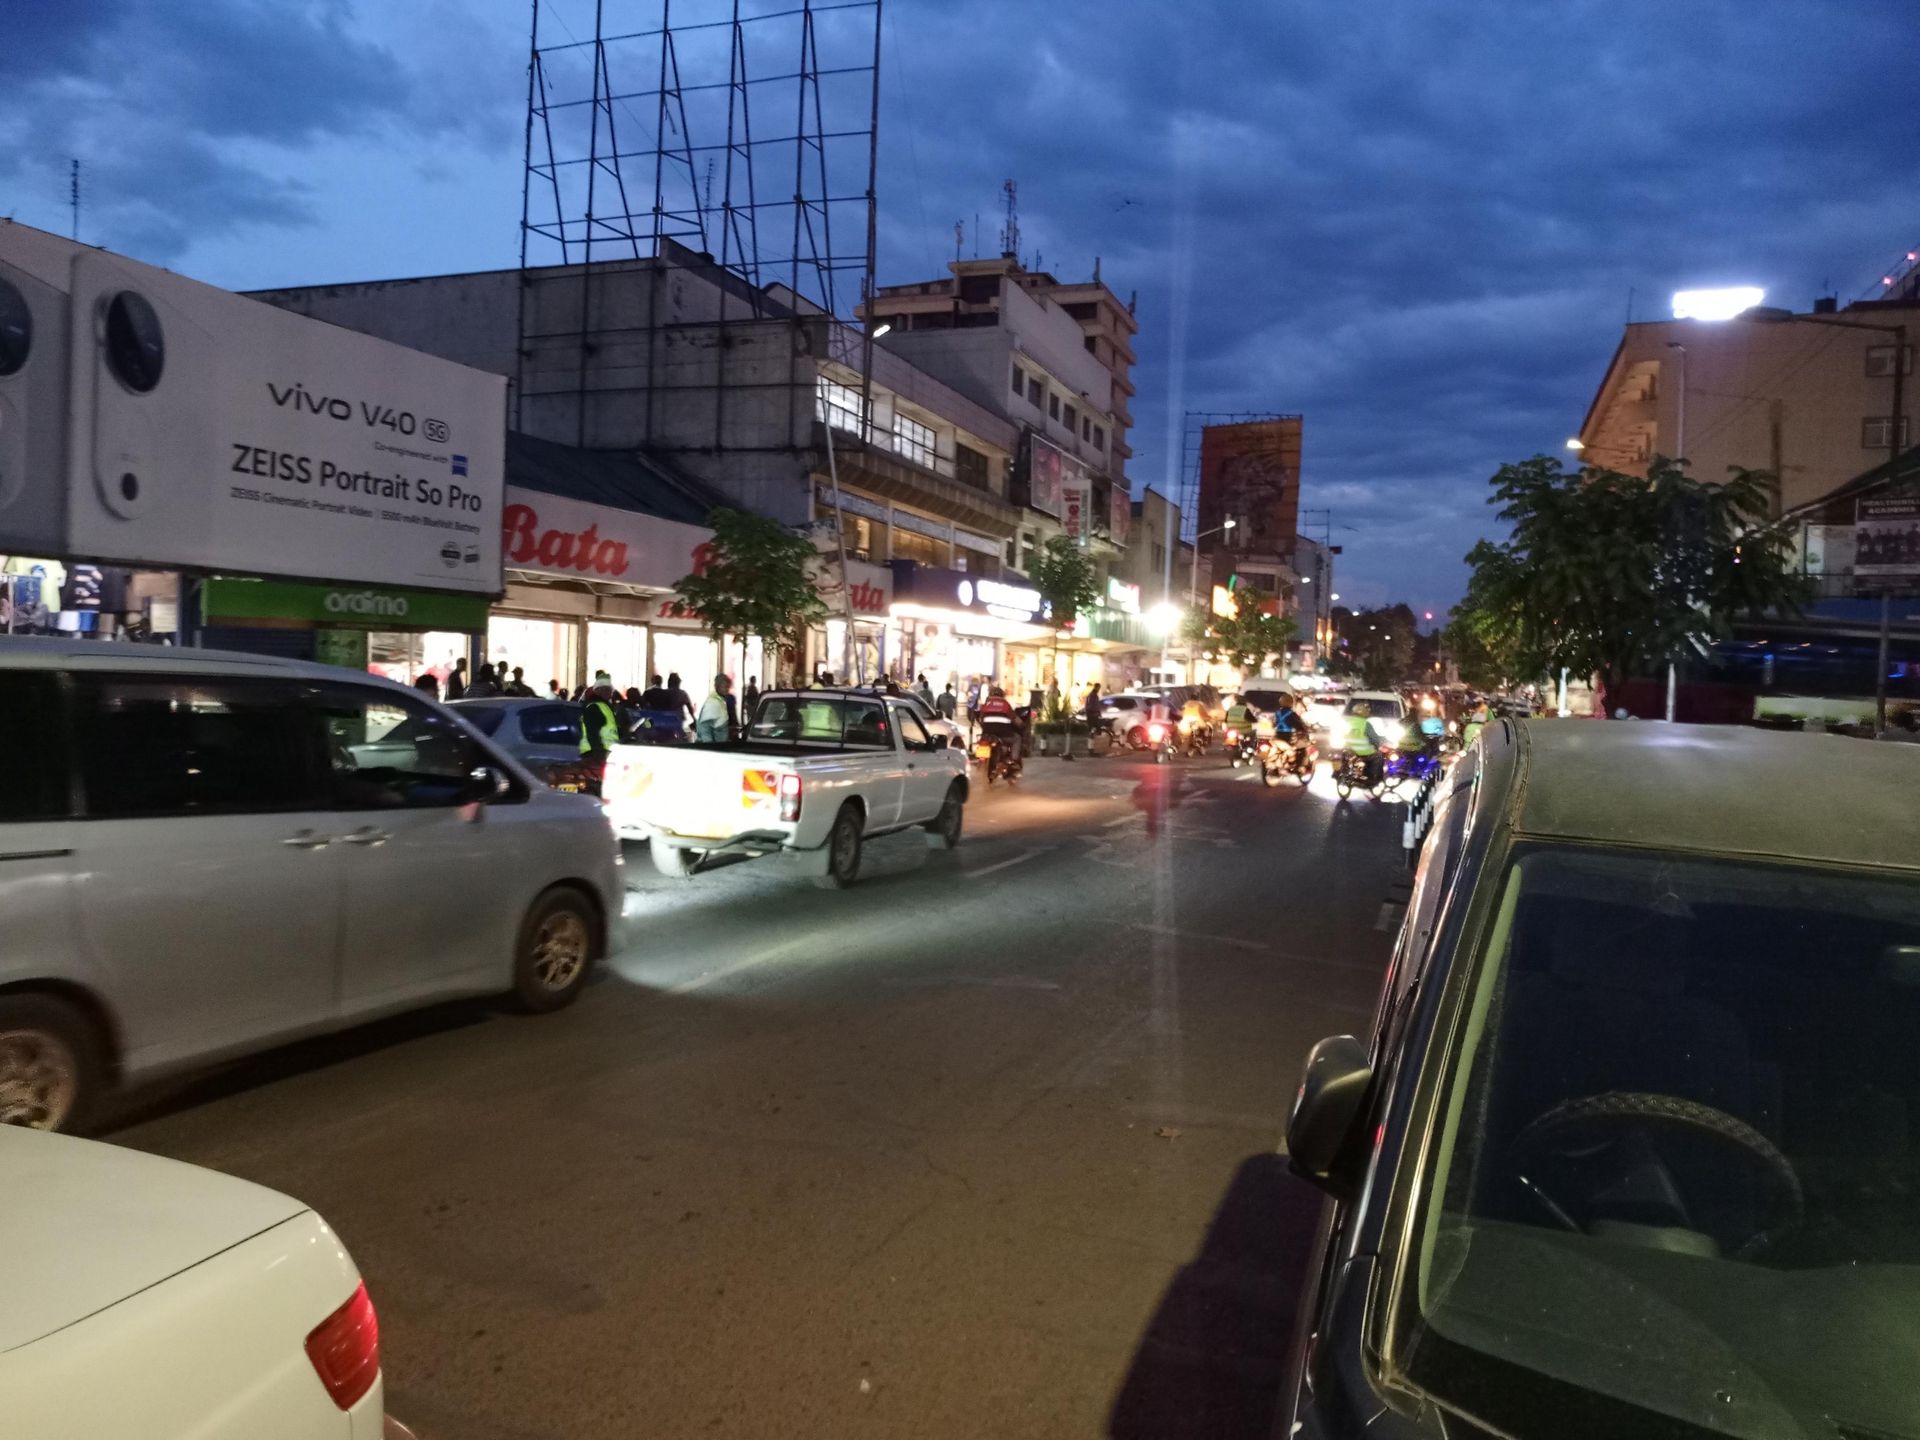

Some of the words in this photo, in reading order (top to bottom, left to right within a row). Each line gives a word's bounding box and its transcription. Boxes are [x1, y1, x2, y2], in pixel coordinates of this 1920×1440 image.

[268, 383, 351, 420] vivo
[361, 401, 416, 436] V40
[425, 420, 448, 441] 5G
[232, 443, 312, 483] ZEISS
[319, 461, 409, 501] Portrait
[416, 479, 442, 505] So
[448, 484, 482, 512] Pro
[503, 504, 629, 576] Bata
[324, 590, 408, 616] oraimo
[848, 578, 885, 612] ata
